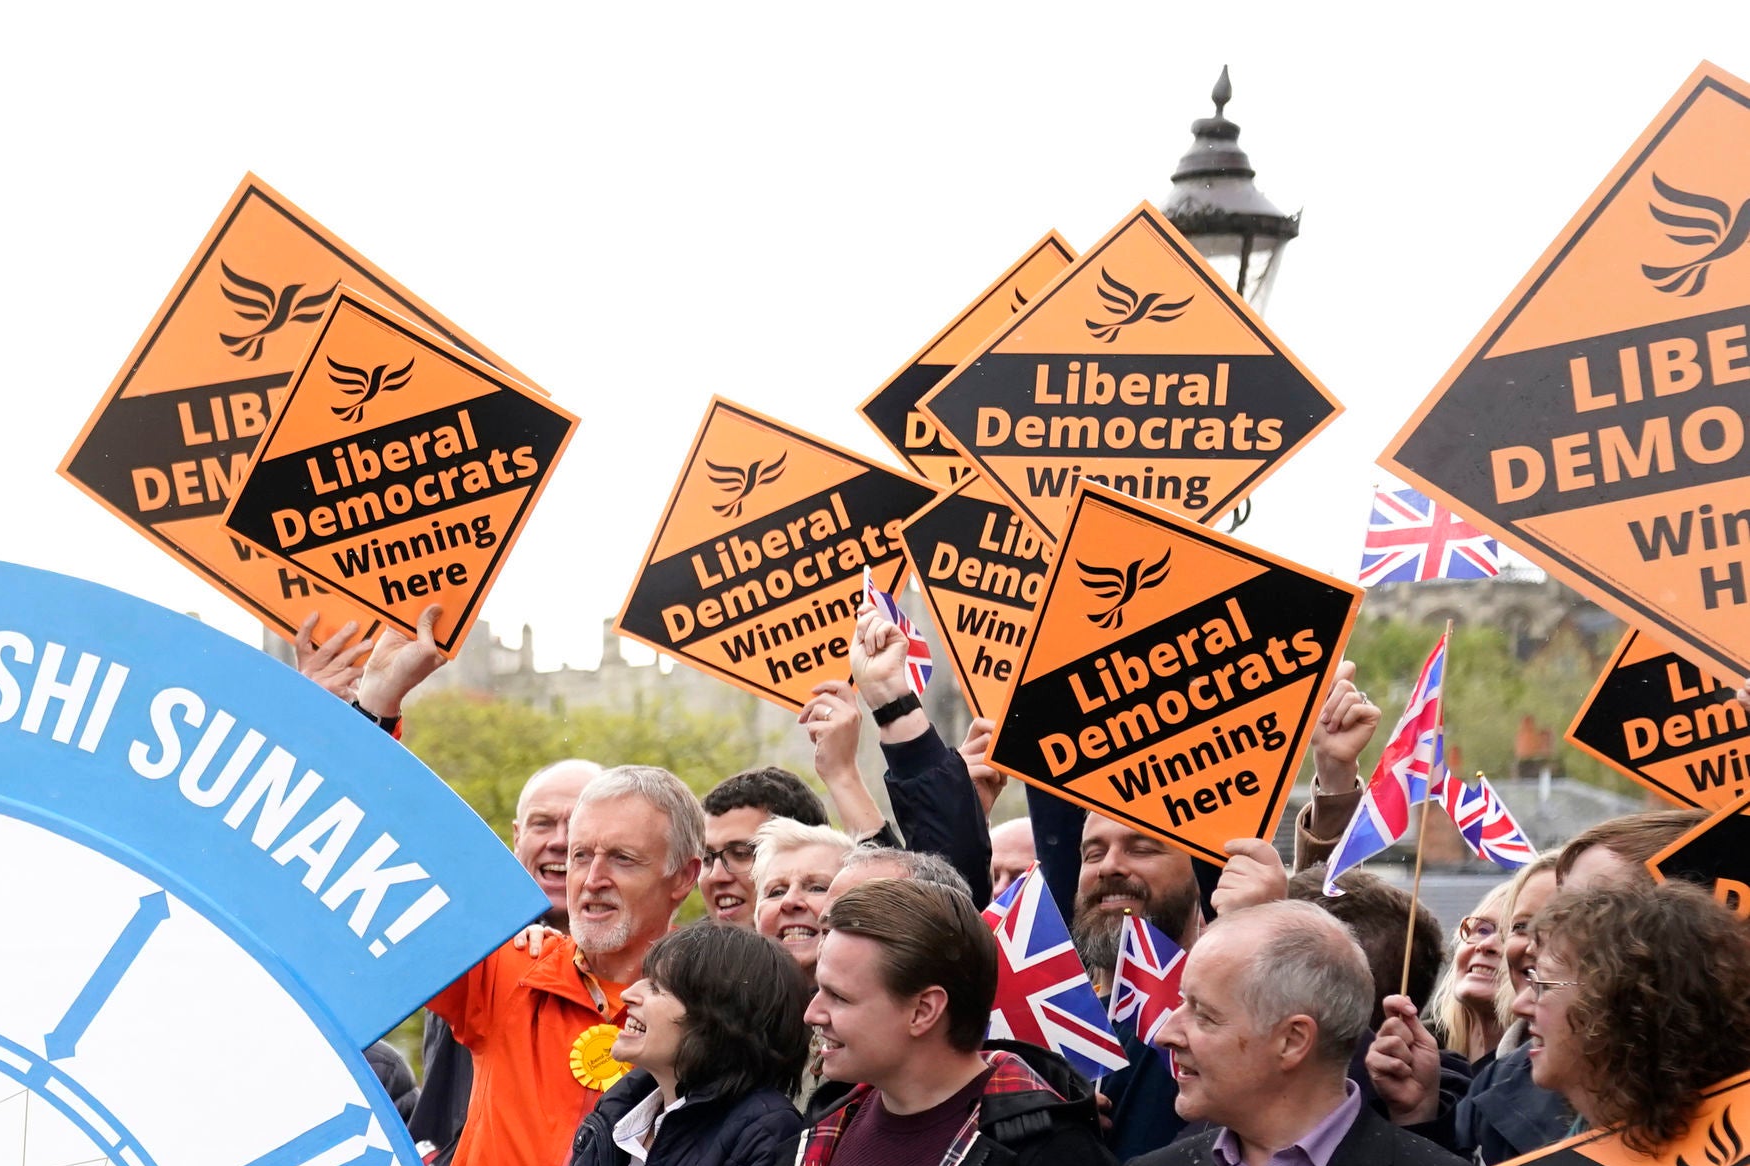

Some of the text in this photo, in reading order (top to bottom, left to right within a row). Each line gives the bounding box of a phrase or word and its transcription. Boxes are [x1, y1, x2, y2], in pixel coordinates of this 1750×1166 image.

[1033, 361, 1230, 407] Liberal
[305, 409, 479, 497] Liberal
[975, 406, 1284, 453] Democrats
[271, 445, 540, 551] Democrats
[690, 491, 852, 591] Liberal
[332, 513, 497, 580] Winning
[379, 562, 469, 606] here
[661, 518, 904, 644] Democrats
[765, 635, 850, 685] here
[1067, 597, 1253, 715] Liberal
[1038, 627, 1323, 778] Democrats
[1107, 711, 1287, 803] Winning
[1162, 769, 1261, 828] here
[128, 687, 451, 959] SUNAK!
